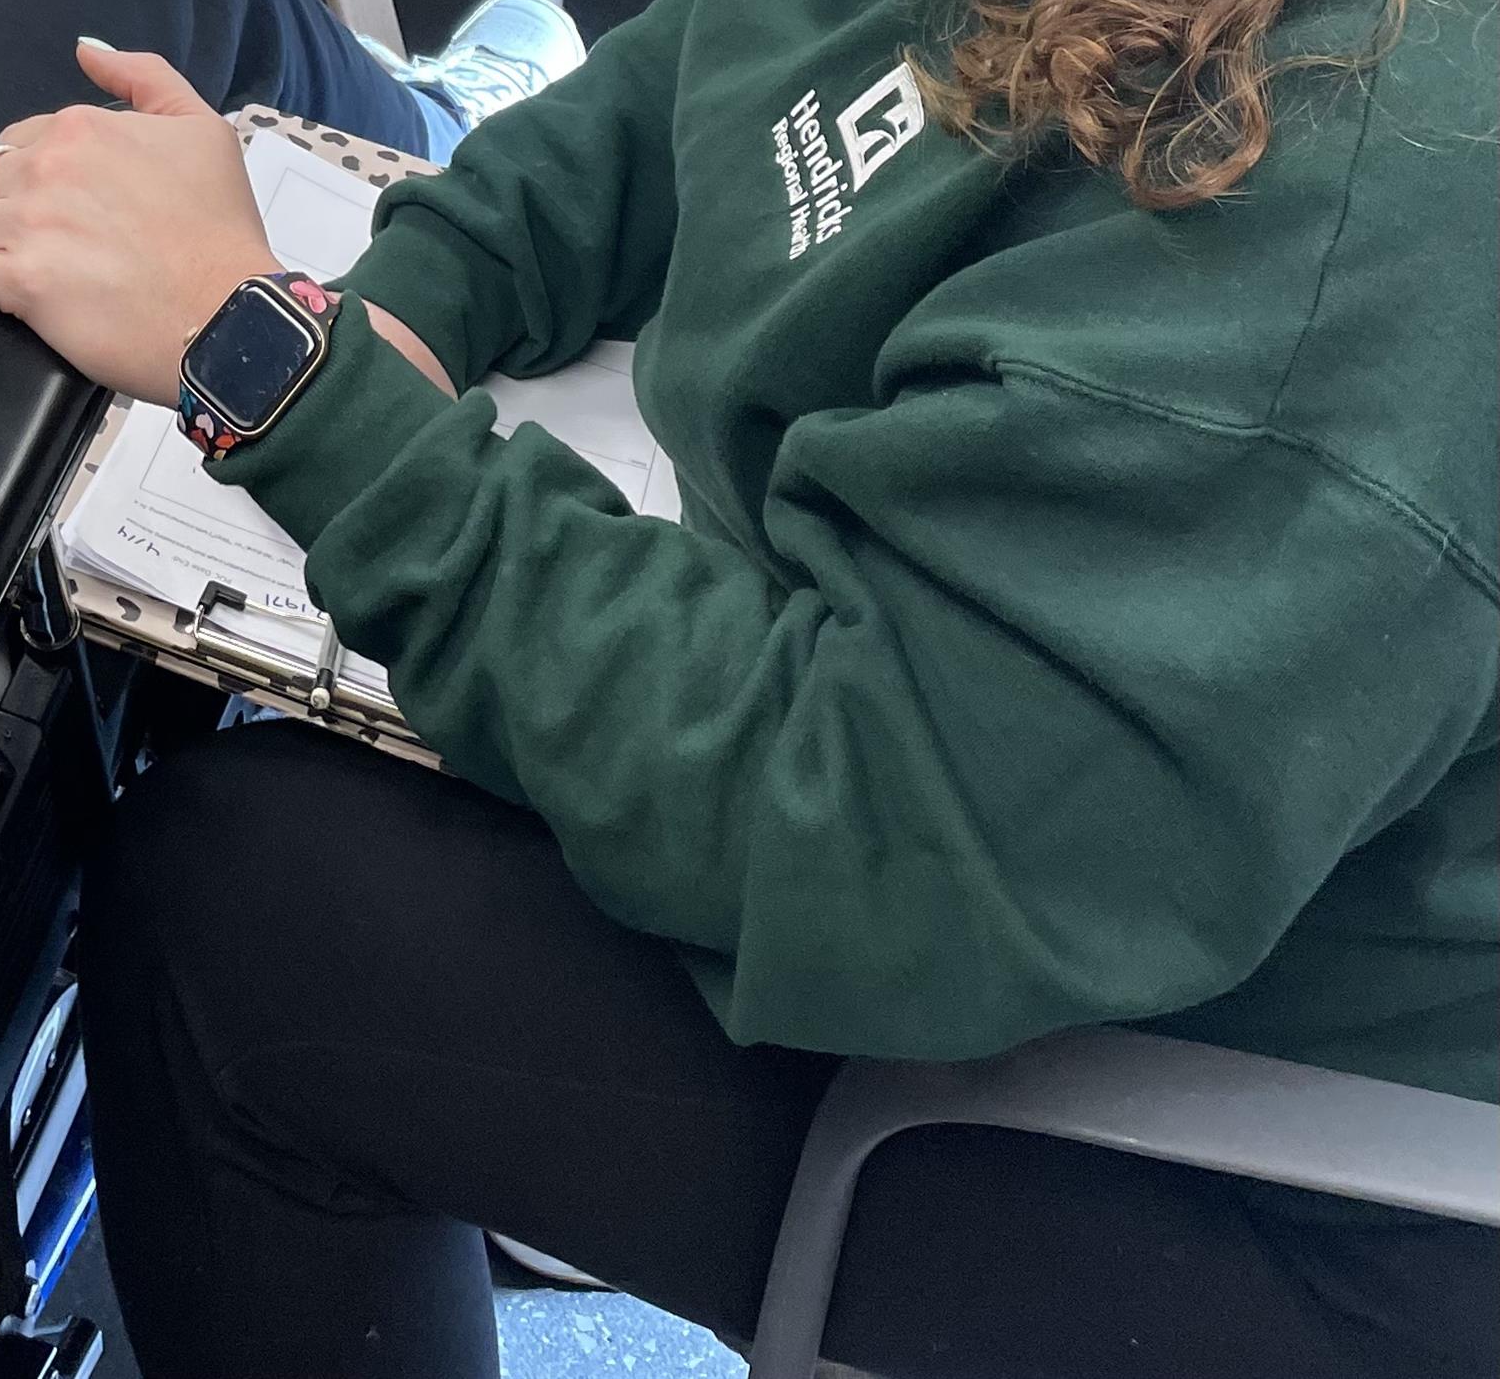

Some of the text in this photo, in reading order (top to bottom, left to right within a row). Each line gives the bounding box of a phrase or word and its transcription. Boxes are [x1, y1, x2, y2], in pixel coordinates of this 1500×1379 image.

[771, 116, 812, 260] Regional Health
[790, 88, 853, 245] Hendricks
